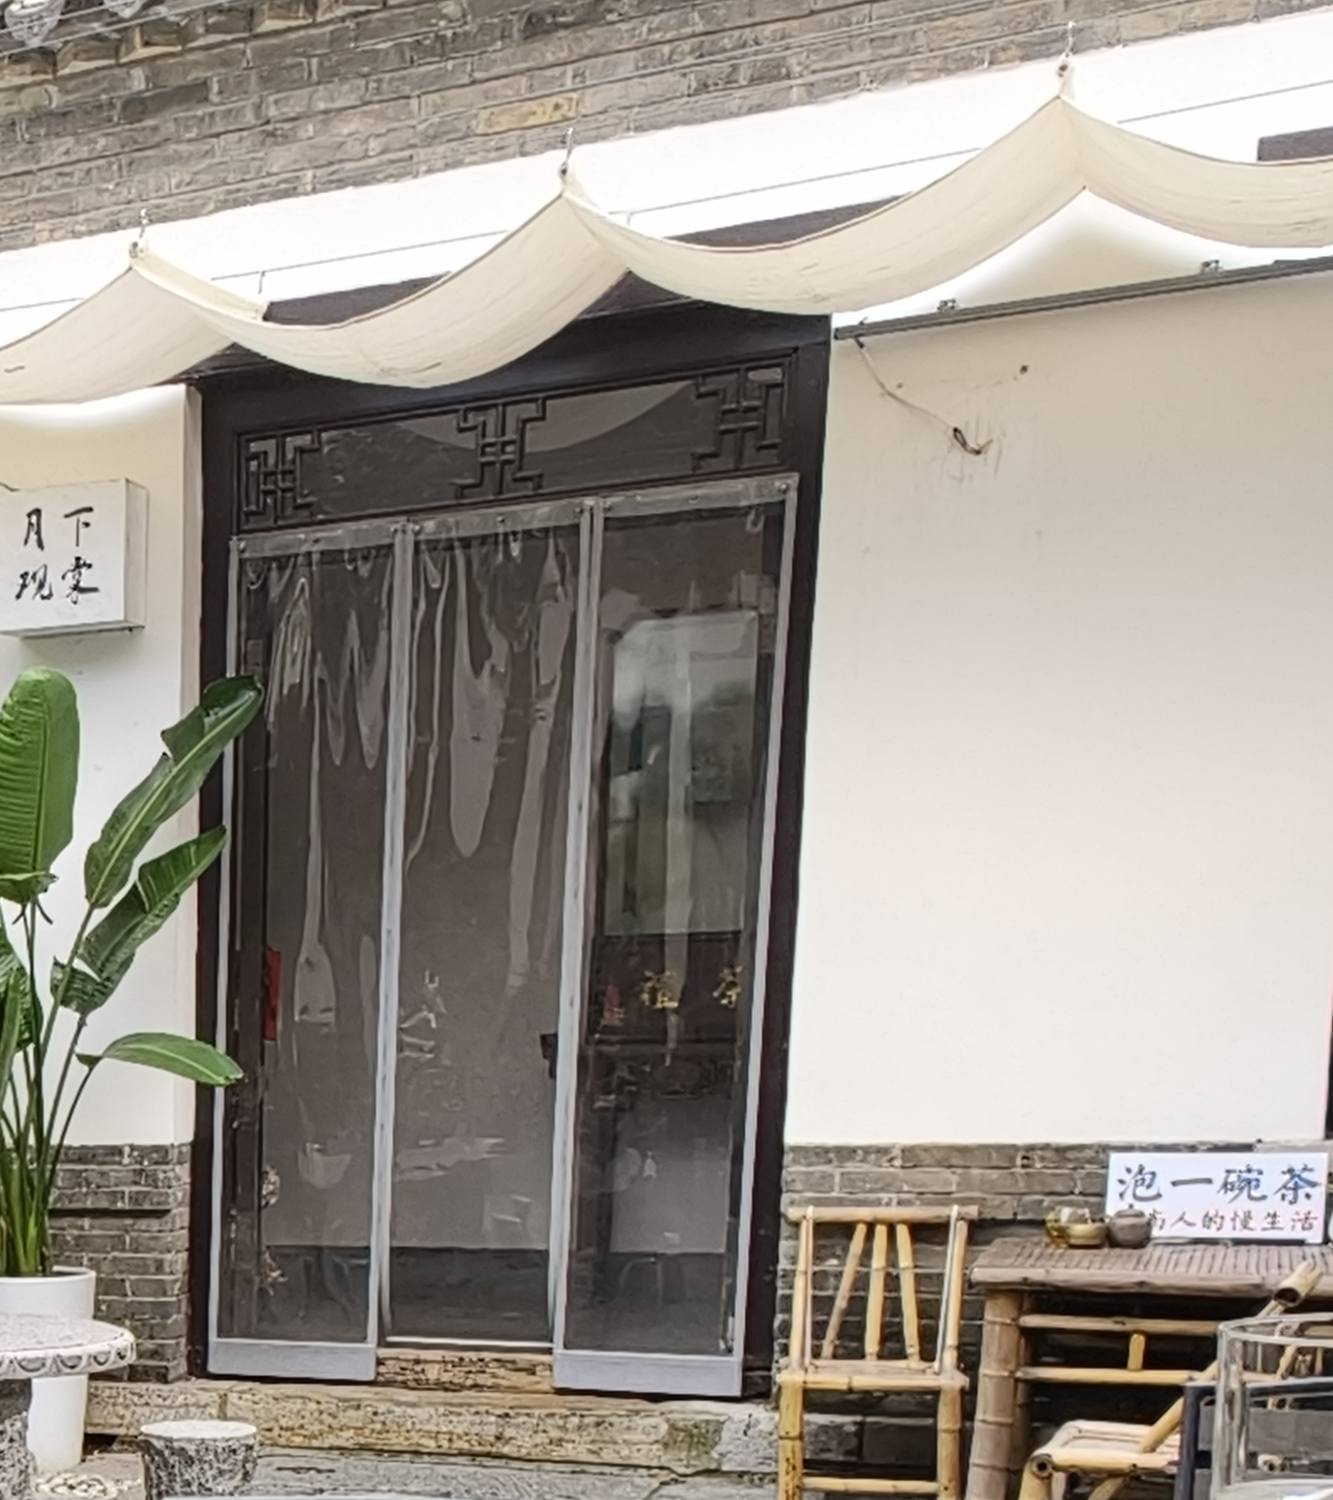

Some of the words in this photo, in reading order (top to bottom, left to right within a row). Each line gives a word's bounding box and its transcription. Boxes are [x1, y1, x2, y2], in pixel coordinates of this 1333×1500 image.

[23, 507, 94, 551] 月下
[1117, 1164, 1321, 1204] 泡一碗茶
